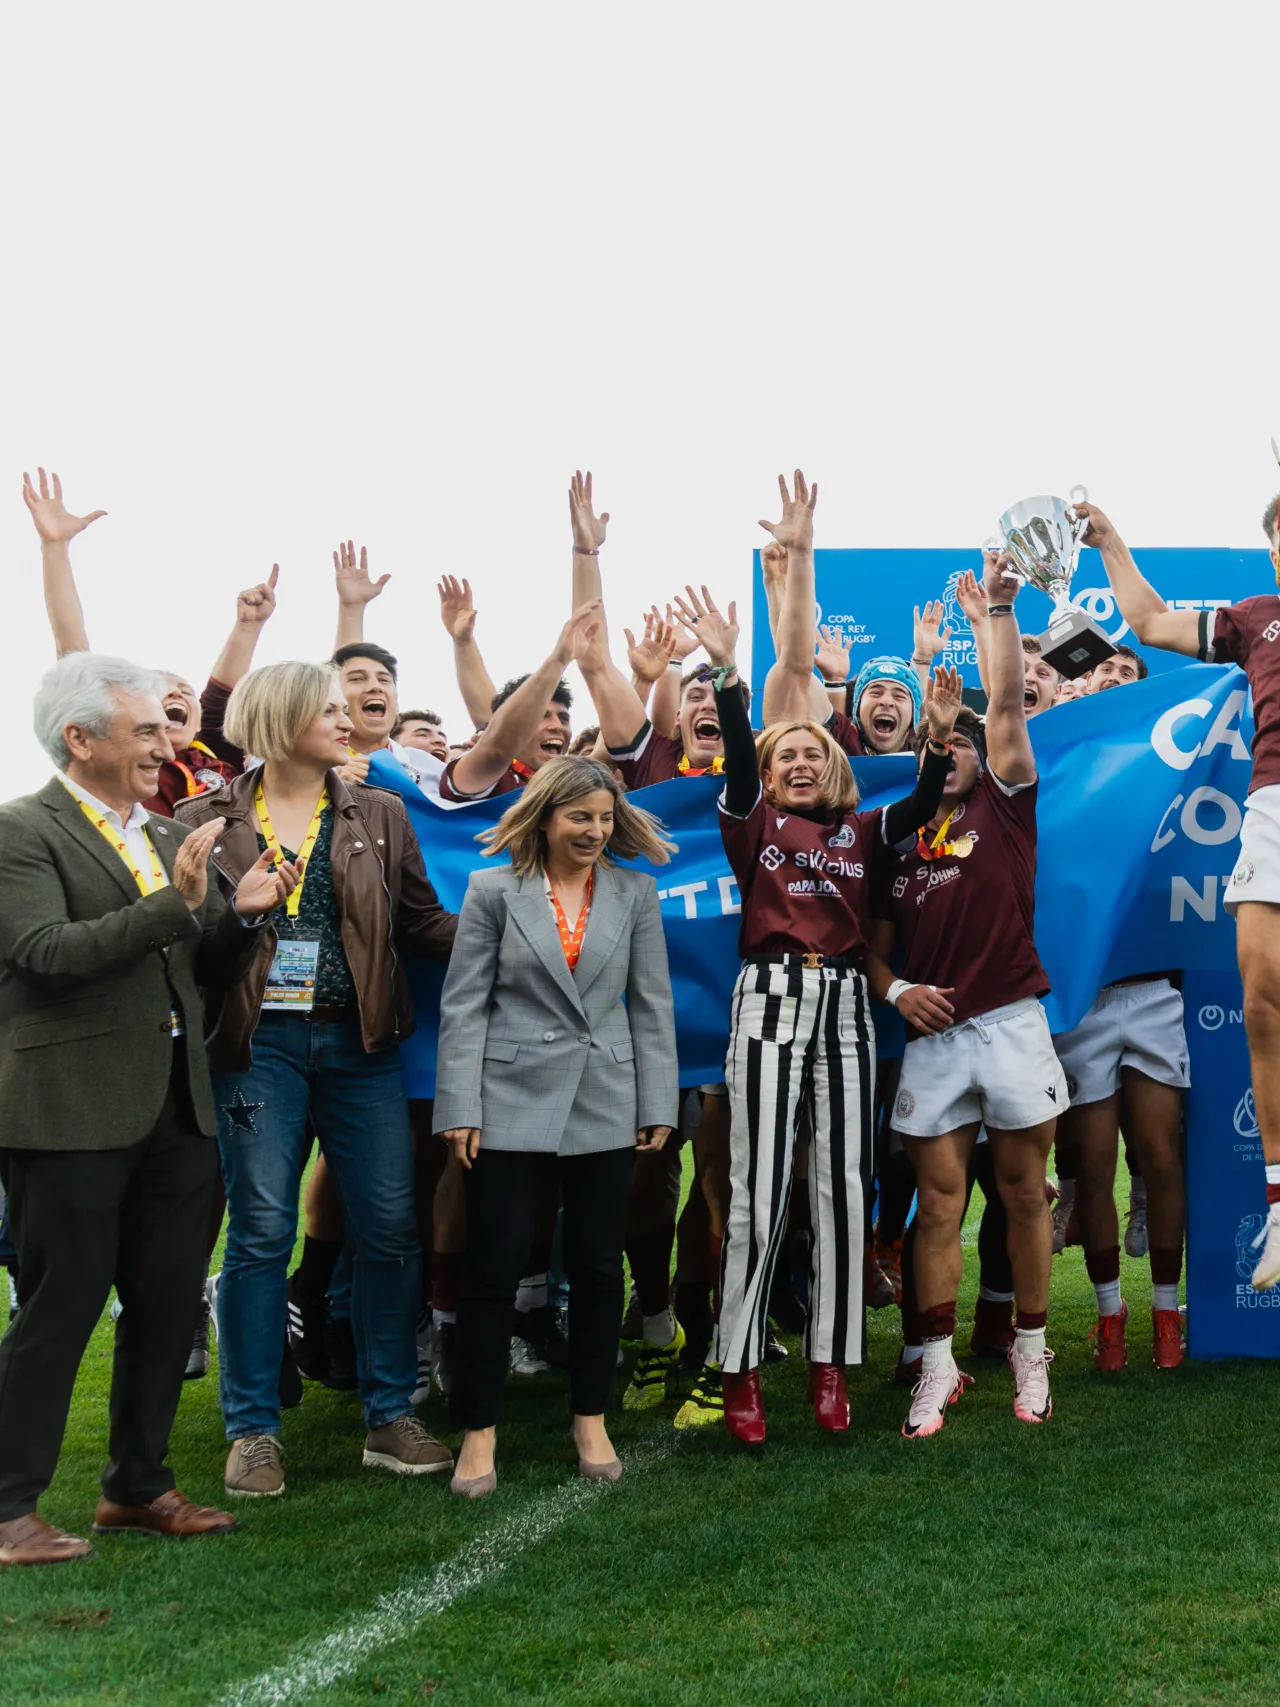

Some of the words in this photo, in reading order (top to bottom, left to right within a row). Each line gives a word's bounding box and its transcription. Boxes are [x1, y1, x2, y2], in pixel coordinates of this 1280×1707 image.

[828, 615, 856, 624] COPA
[848, 625, 866, 633] REY
[943, 652, 977, 665] RUG
[1150, 785, 1242, 854] CO
[795, 848, 864, 879] silicius
[787, 880, 816, 893] PAPA
[1233, 1144, 1256, 1152] COPA
